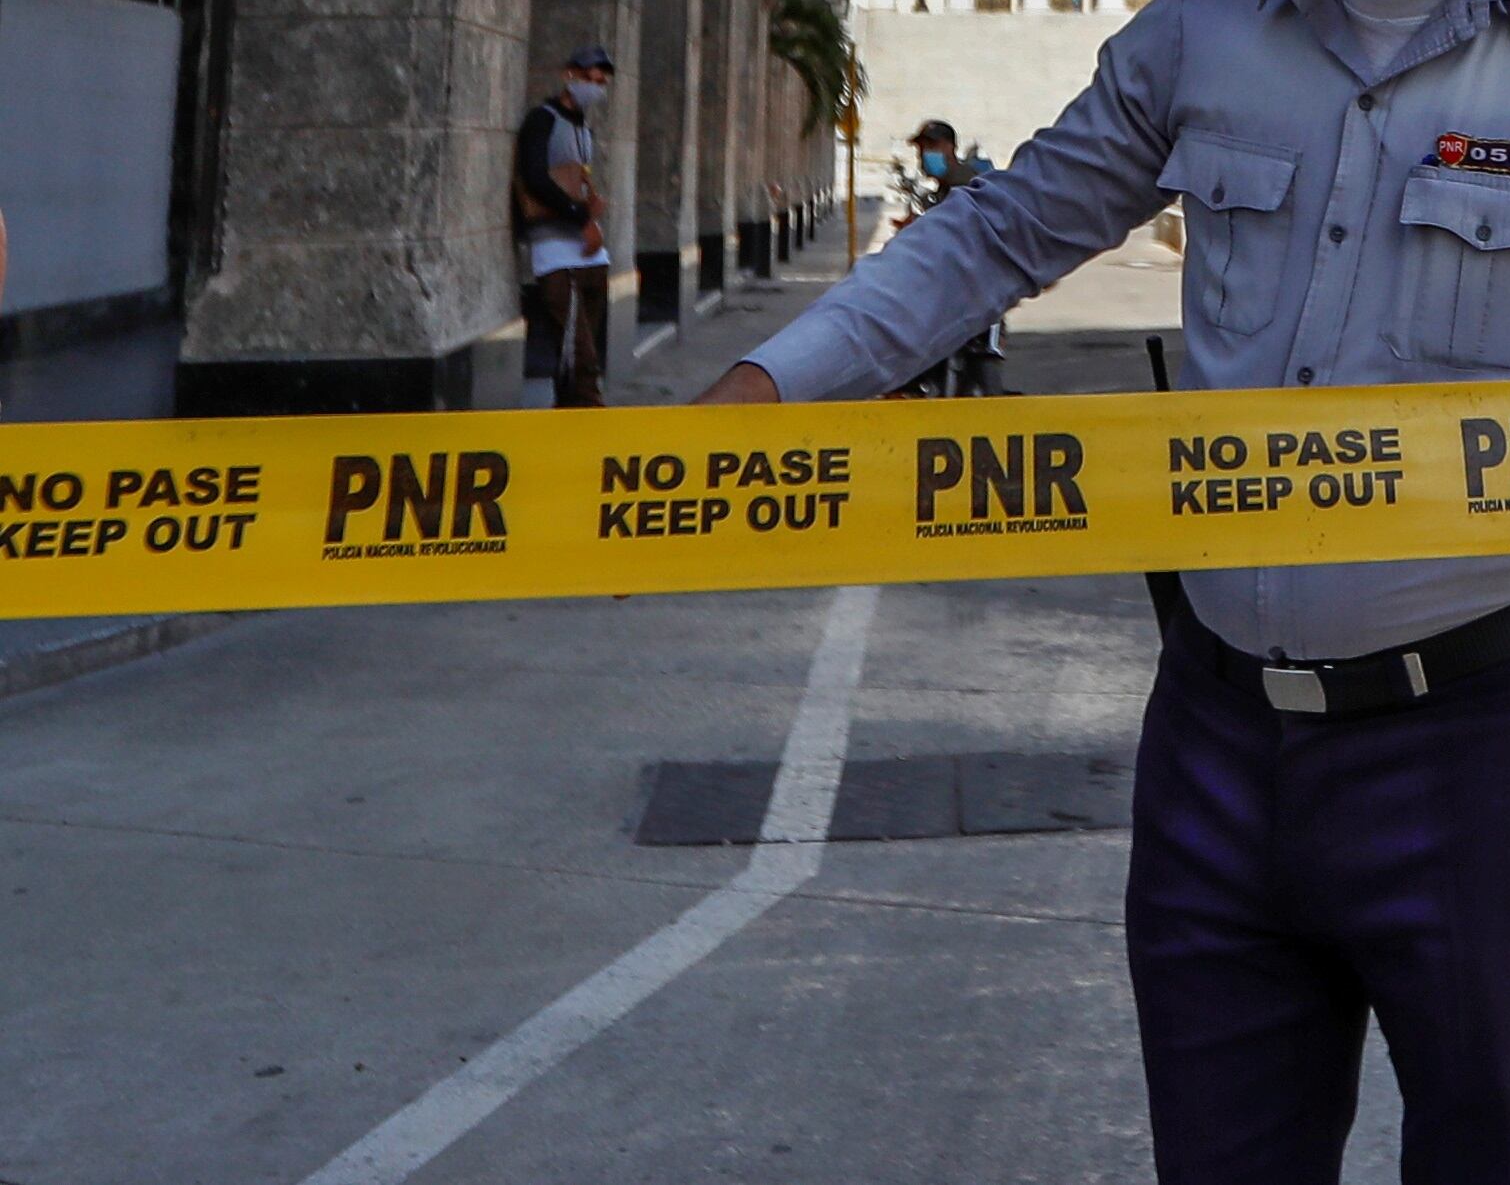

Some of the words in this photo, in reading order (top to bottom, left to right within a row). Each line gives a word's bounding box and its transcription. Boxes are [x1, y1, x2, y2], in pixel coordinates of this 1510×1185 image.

[1439, 141, 1463, 153] PNR
[602, 455, 685, 492] NO
[707, 448, 850, 488] PASE
[1169, 436, 1247, 472] NO
[1267, 429, 1401, 467] PASE
[0, 472, 83, 512] NO
[107, 466, 261, 508] PASE
[326, 451, 509, 543] PNR
[917, 433, 1087, 522] PNR
[1172, 477, 1292, 515] KEEP
[1309, 470, 1403, 508] OUT
[600, 498, 730, 538] KEEP
[748, 492, 849, 531] OUT
[1468, 499, 1503, 514] POLICIA
[0, 519, 127, 558] KEEP
[146, 513, 256, 552] OUT
